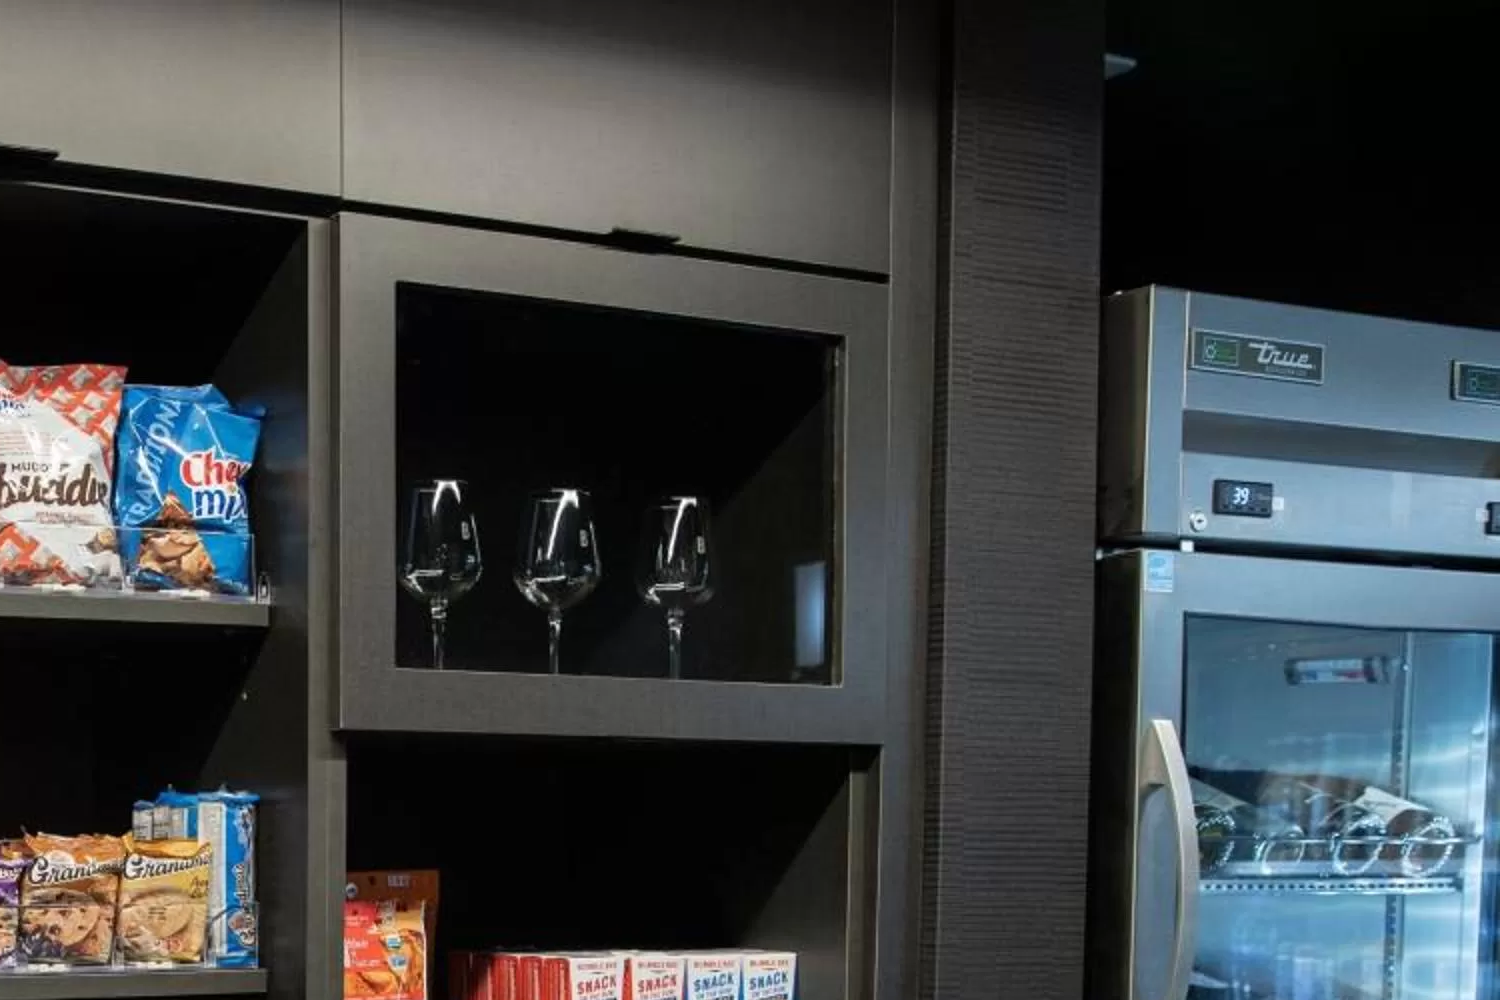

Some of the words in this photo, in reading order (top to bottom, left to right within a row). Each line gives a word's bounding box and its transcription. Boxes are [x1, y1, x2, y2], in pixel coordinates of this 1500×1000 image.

[1232, 487, 1249, 505] 39
[577, 974, 618, 995] SNACK
[637, 974, 678, 994] SNACK
[693, 972, 735, 992] SNACK
[748, 971, 789, 991] SNACK
